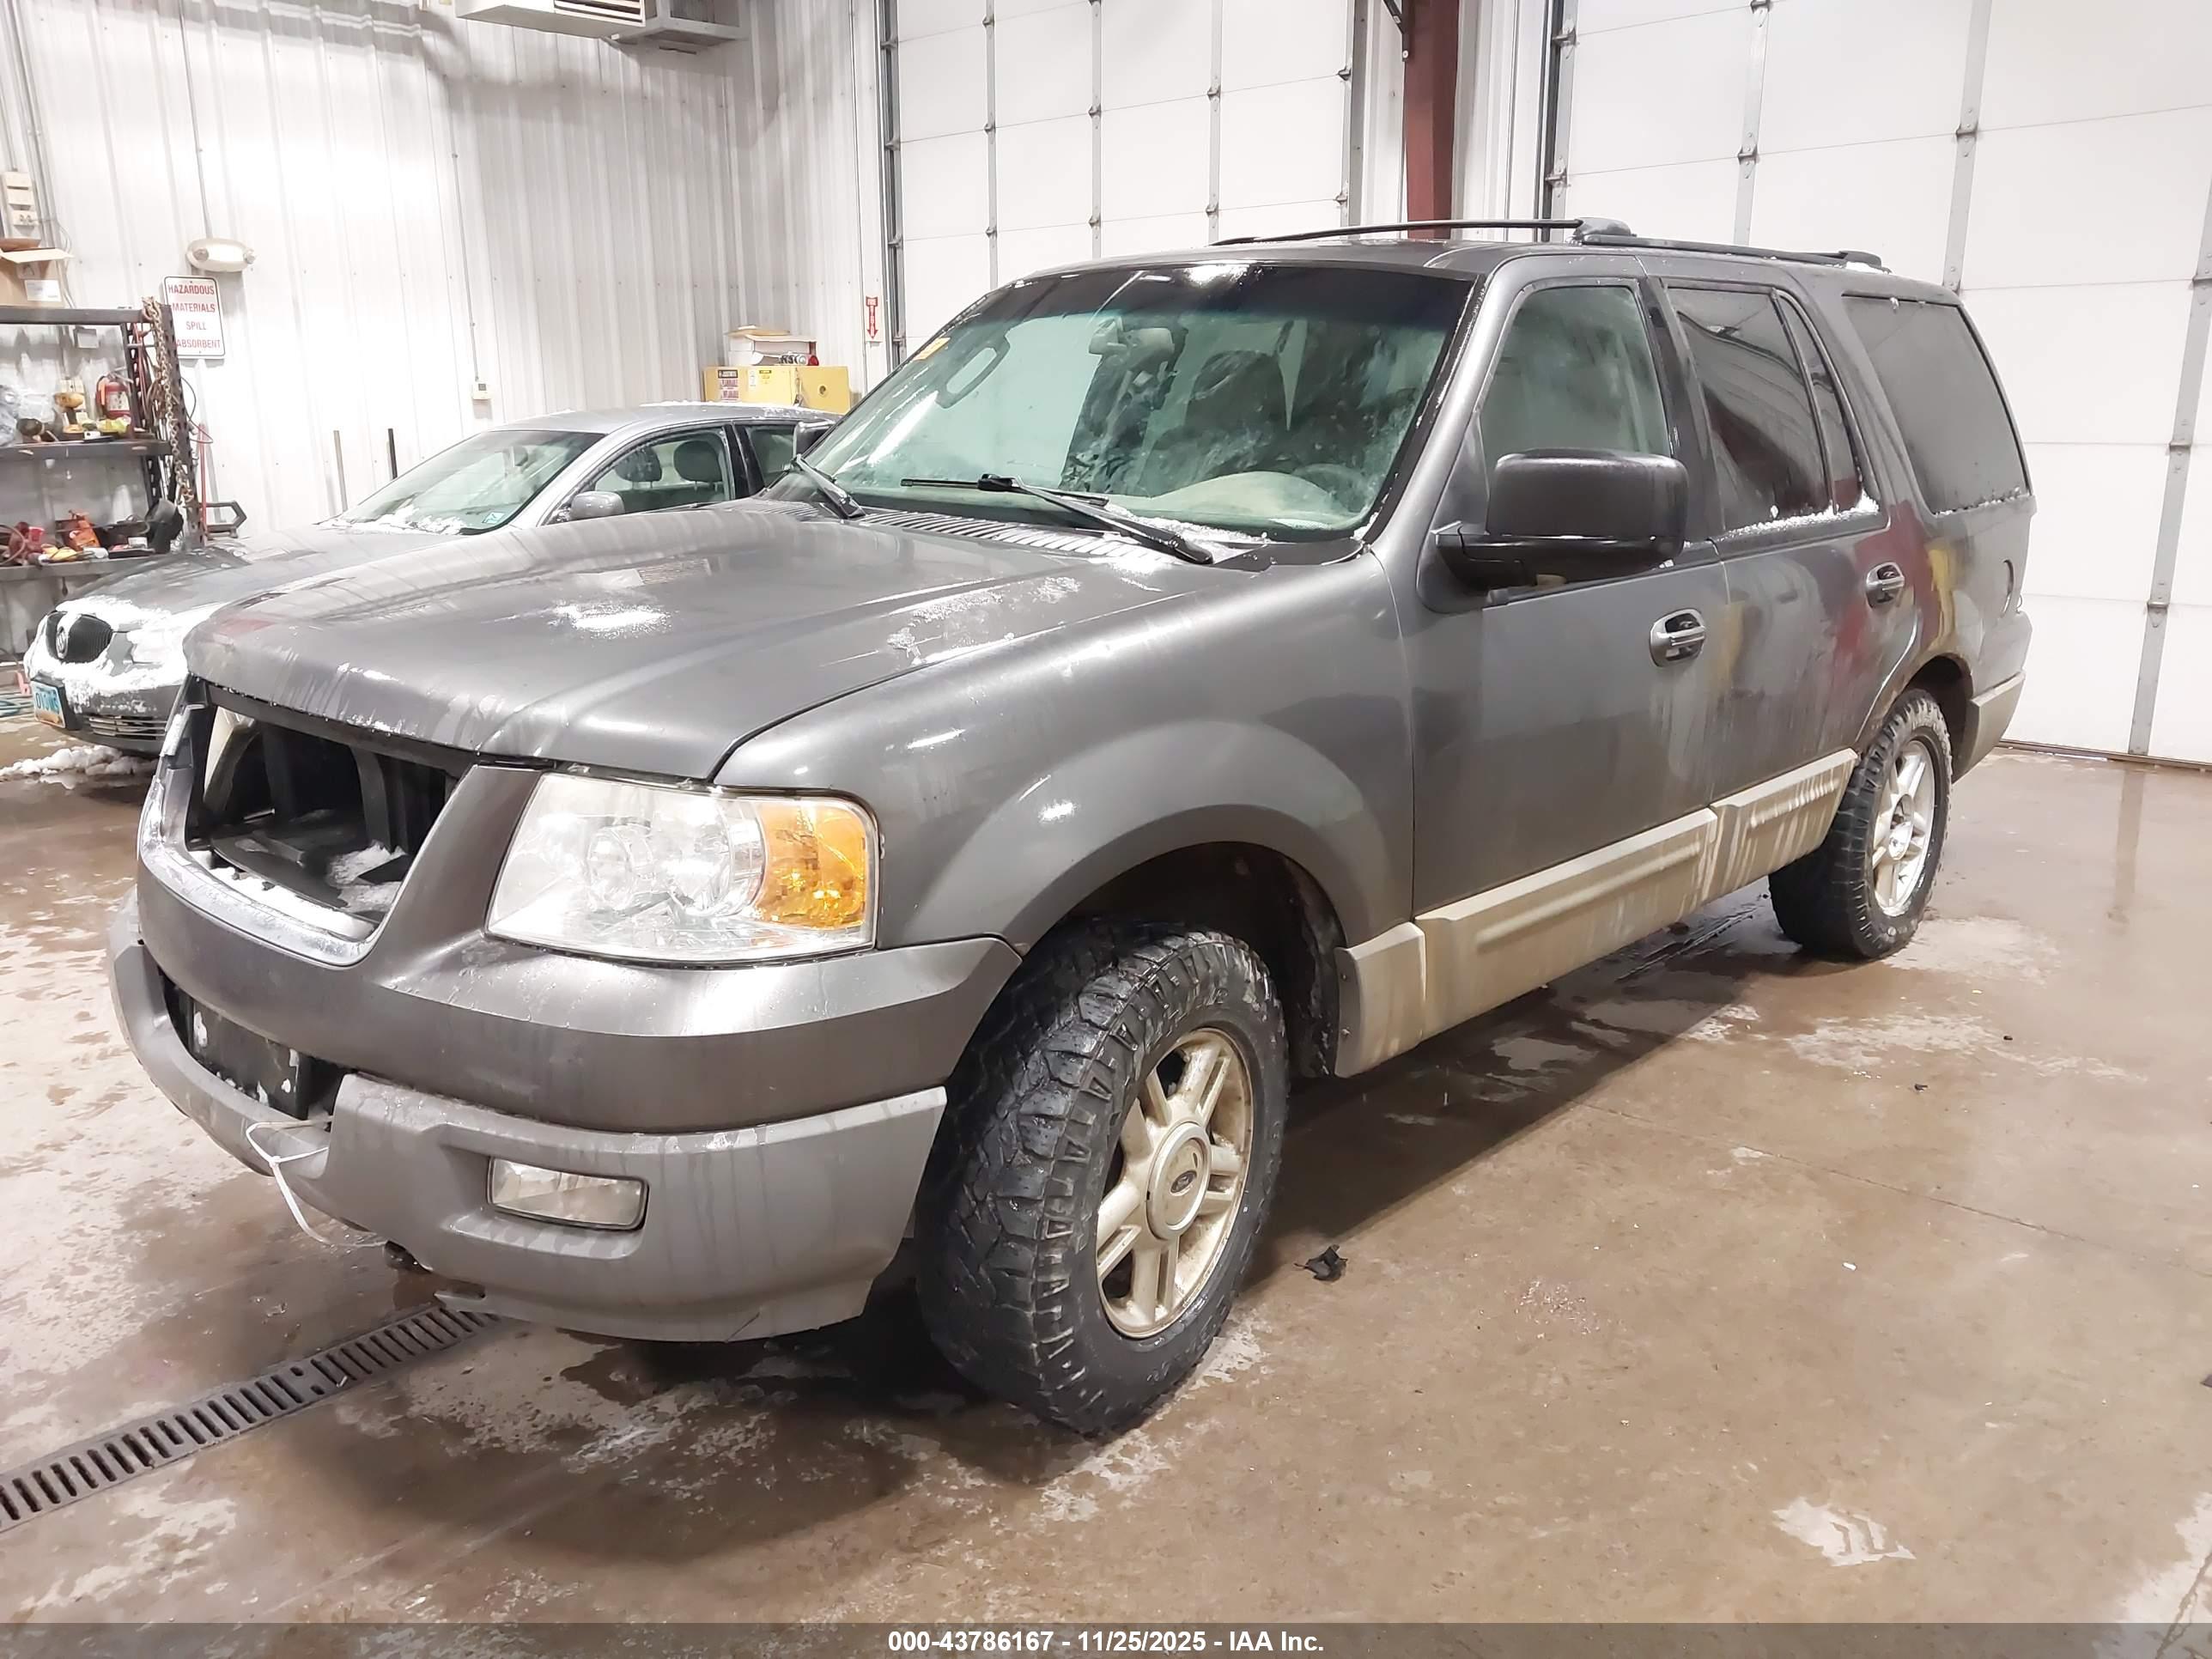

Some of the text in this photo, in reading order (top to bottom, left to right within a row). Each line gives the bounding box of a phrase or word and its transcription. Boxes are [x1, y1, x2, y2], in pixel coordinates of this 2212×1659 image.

[167, 284, 215, 295] HAZARDOUS
[172, 302, 216, 313] MATERIALS
[185, 320, 207, 331] SPILL
[177, 339, 221, 349] ABSORBENT
